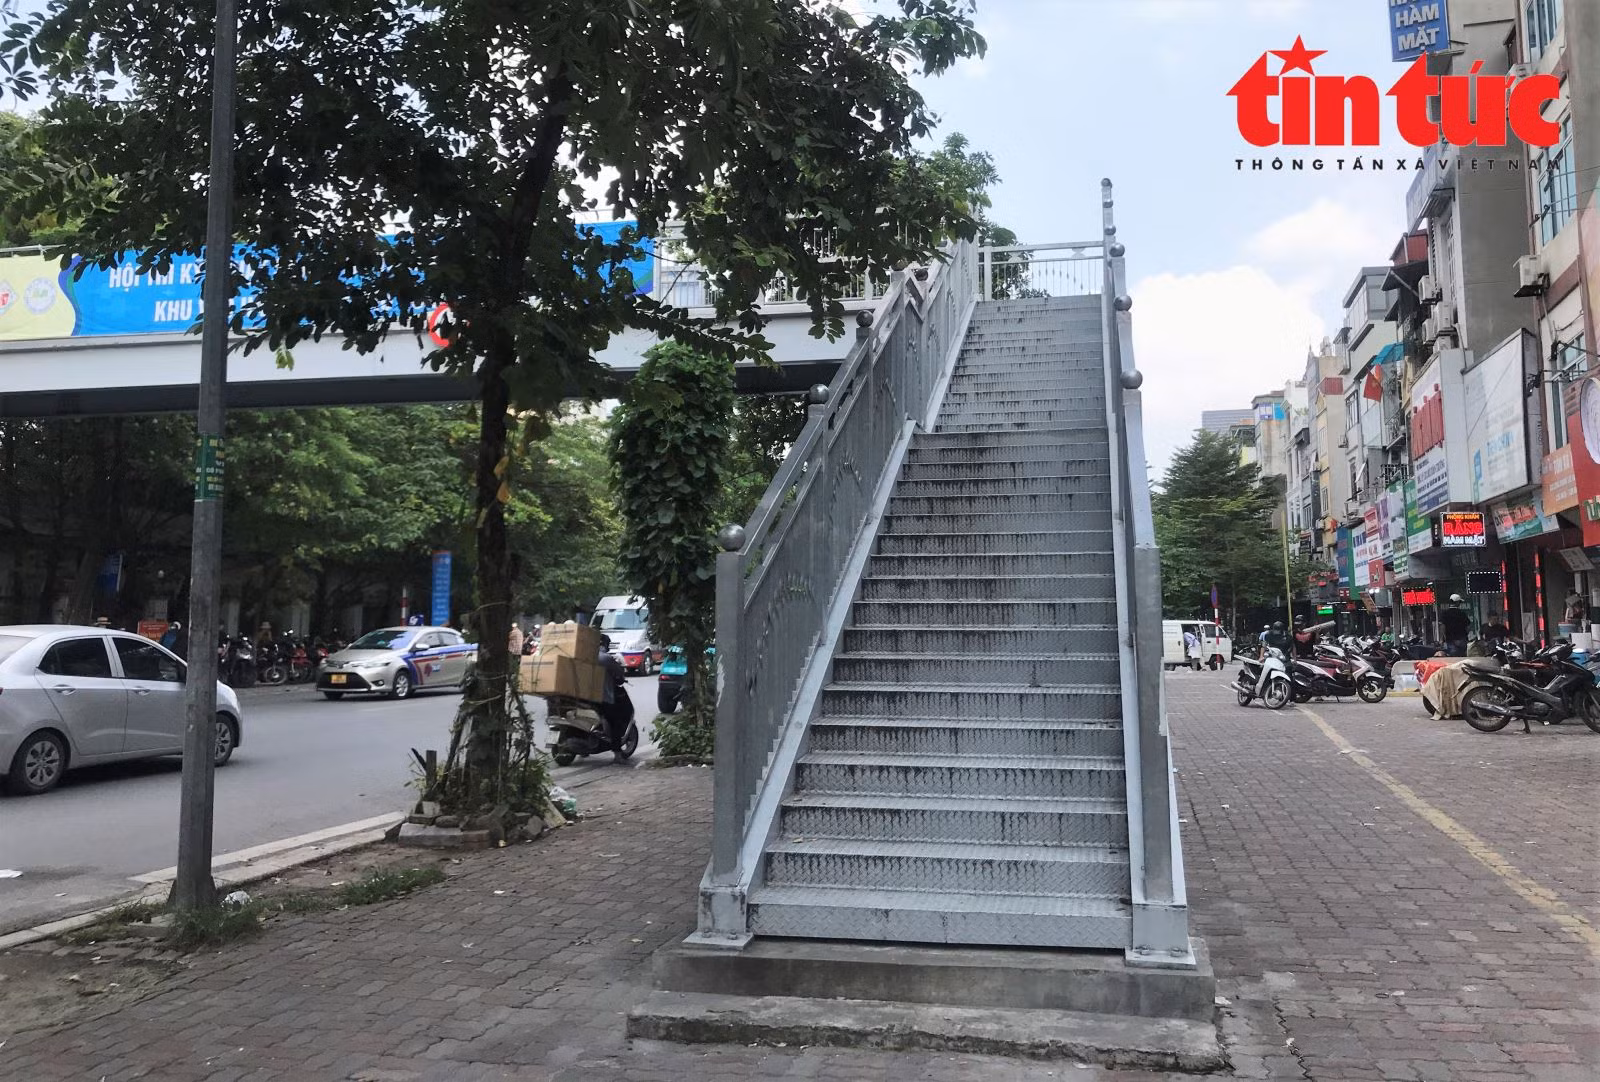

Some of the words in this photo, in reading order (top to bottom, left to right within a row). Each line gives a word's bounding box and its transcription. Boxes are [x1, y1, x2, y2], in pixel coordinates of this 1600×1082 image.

[1395, 3, 1439, 28] HÀM
[1397, 25, 1440, 51] MẶT
[153, 299, 193, 322] KHU
[1443, 518, 1483, 535] RĂNG
